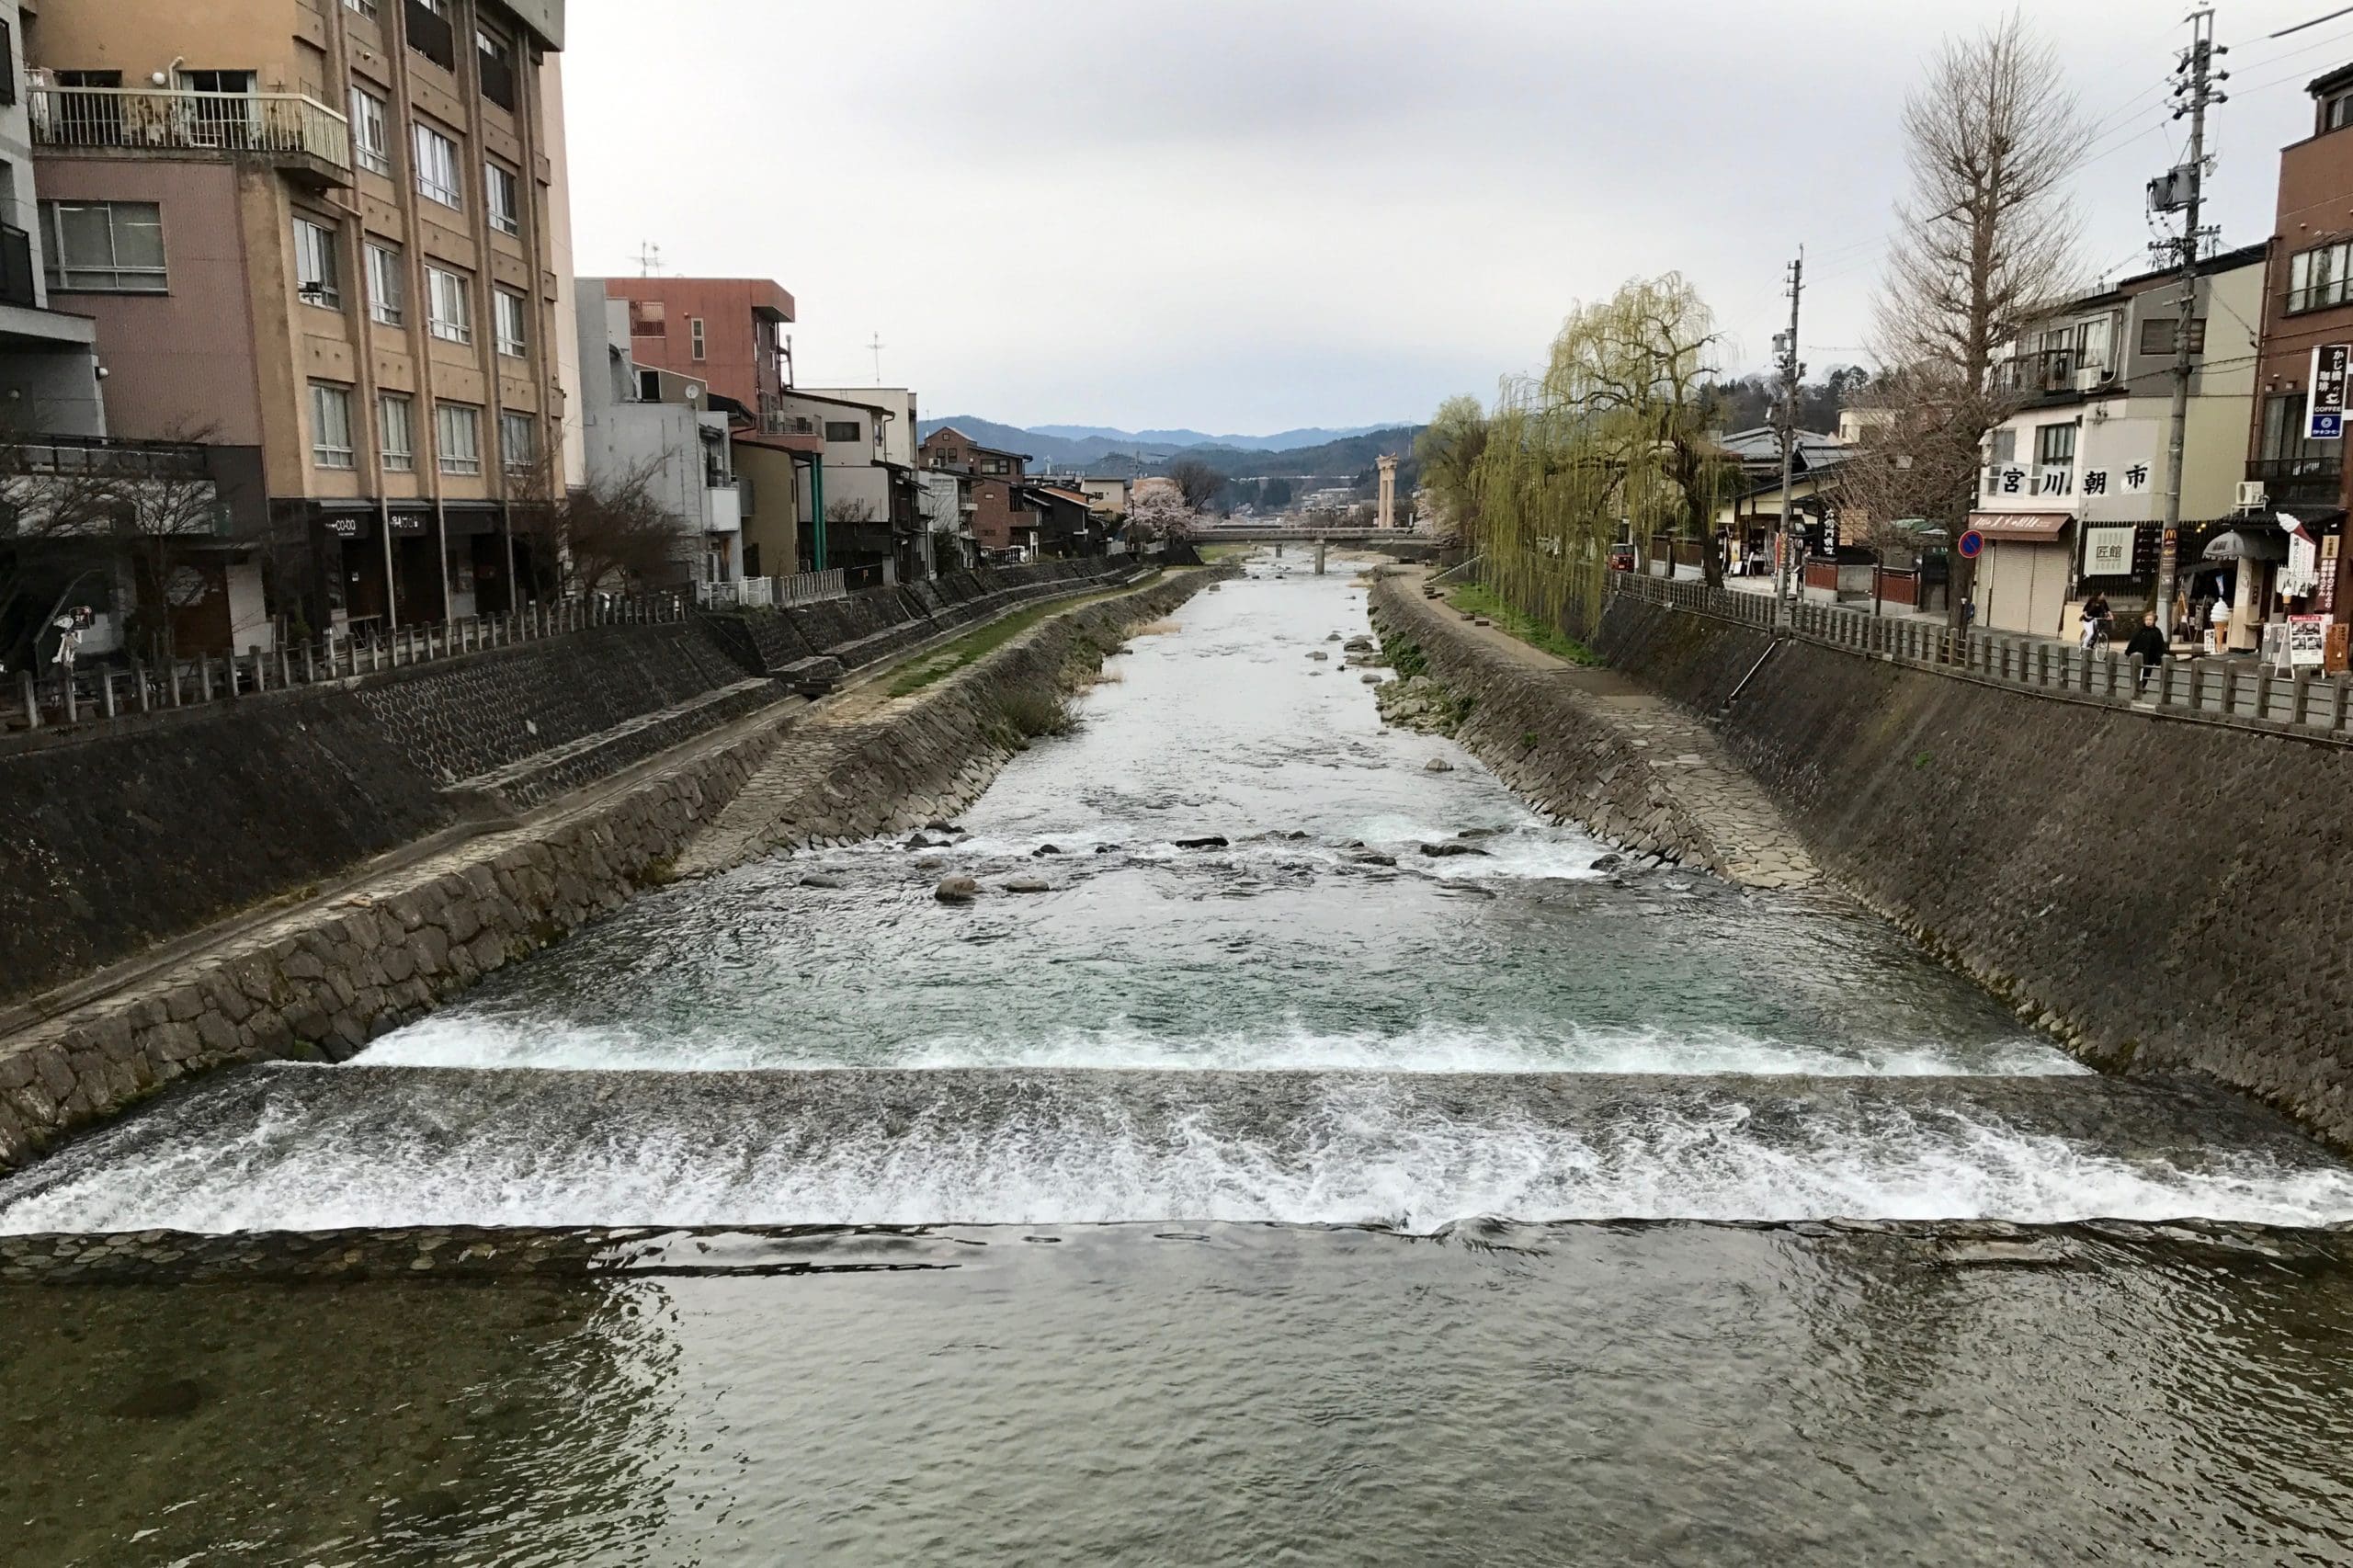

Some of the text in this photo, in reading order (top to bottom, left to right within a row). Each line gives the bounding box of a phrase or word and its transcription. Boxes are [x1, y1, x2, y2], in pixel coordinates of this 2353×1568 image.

[2003, 464, 2148, 496] 宮川朝市
[2096, 545, 2122, 559] 匠館
